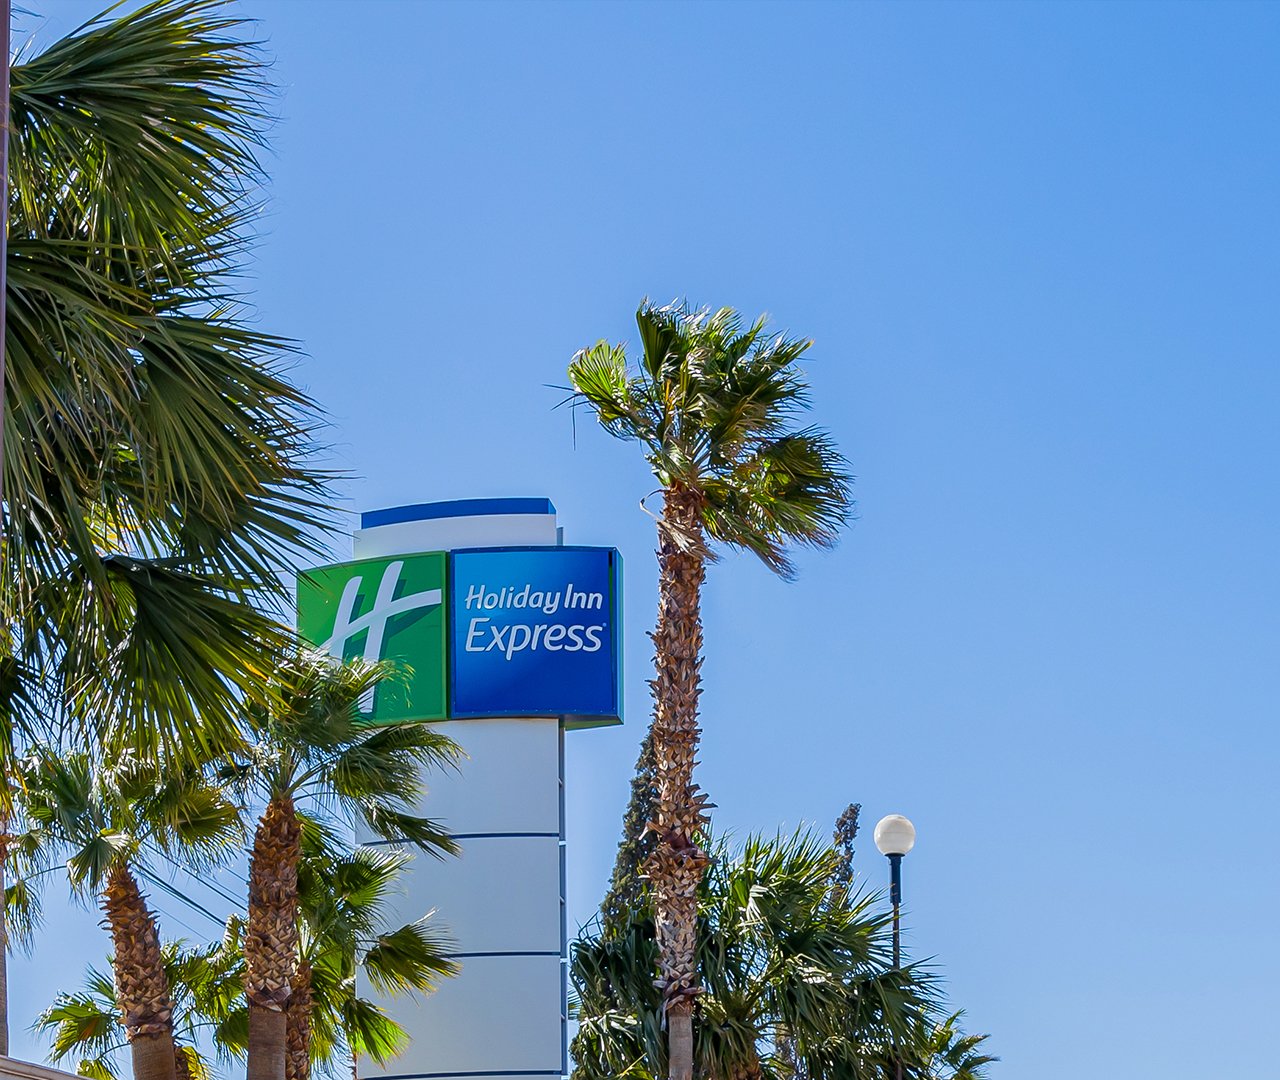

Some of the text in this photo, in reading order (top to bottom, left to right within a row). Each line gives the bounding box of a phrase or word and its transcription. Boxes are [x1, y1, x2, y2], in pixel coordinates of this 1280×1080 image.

[465, 583, 603, 614] Holiday Inn
[465, 617, 603, 661] Express
